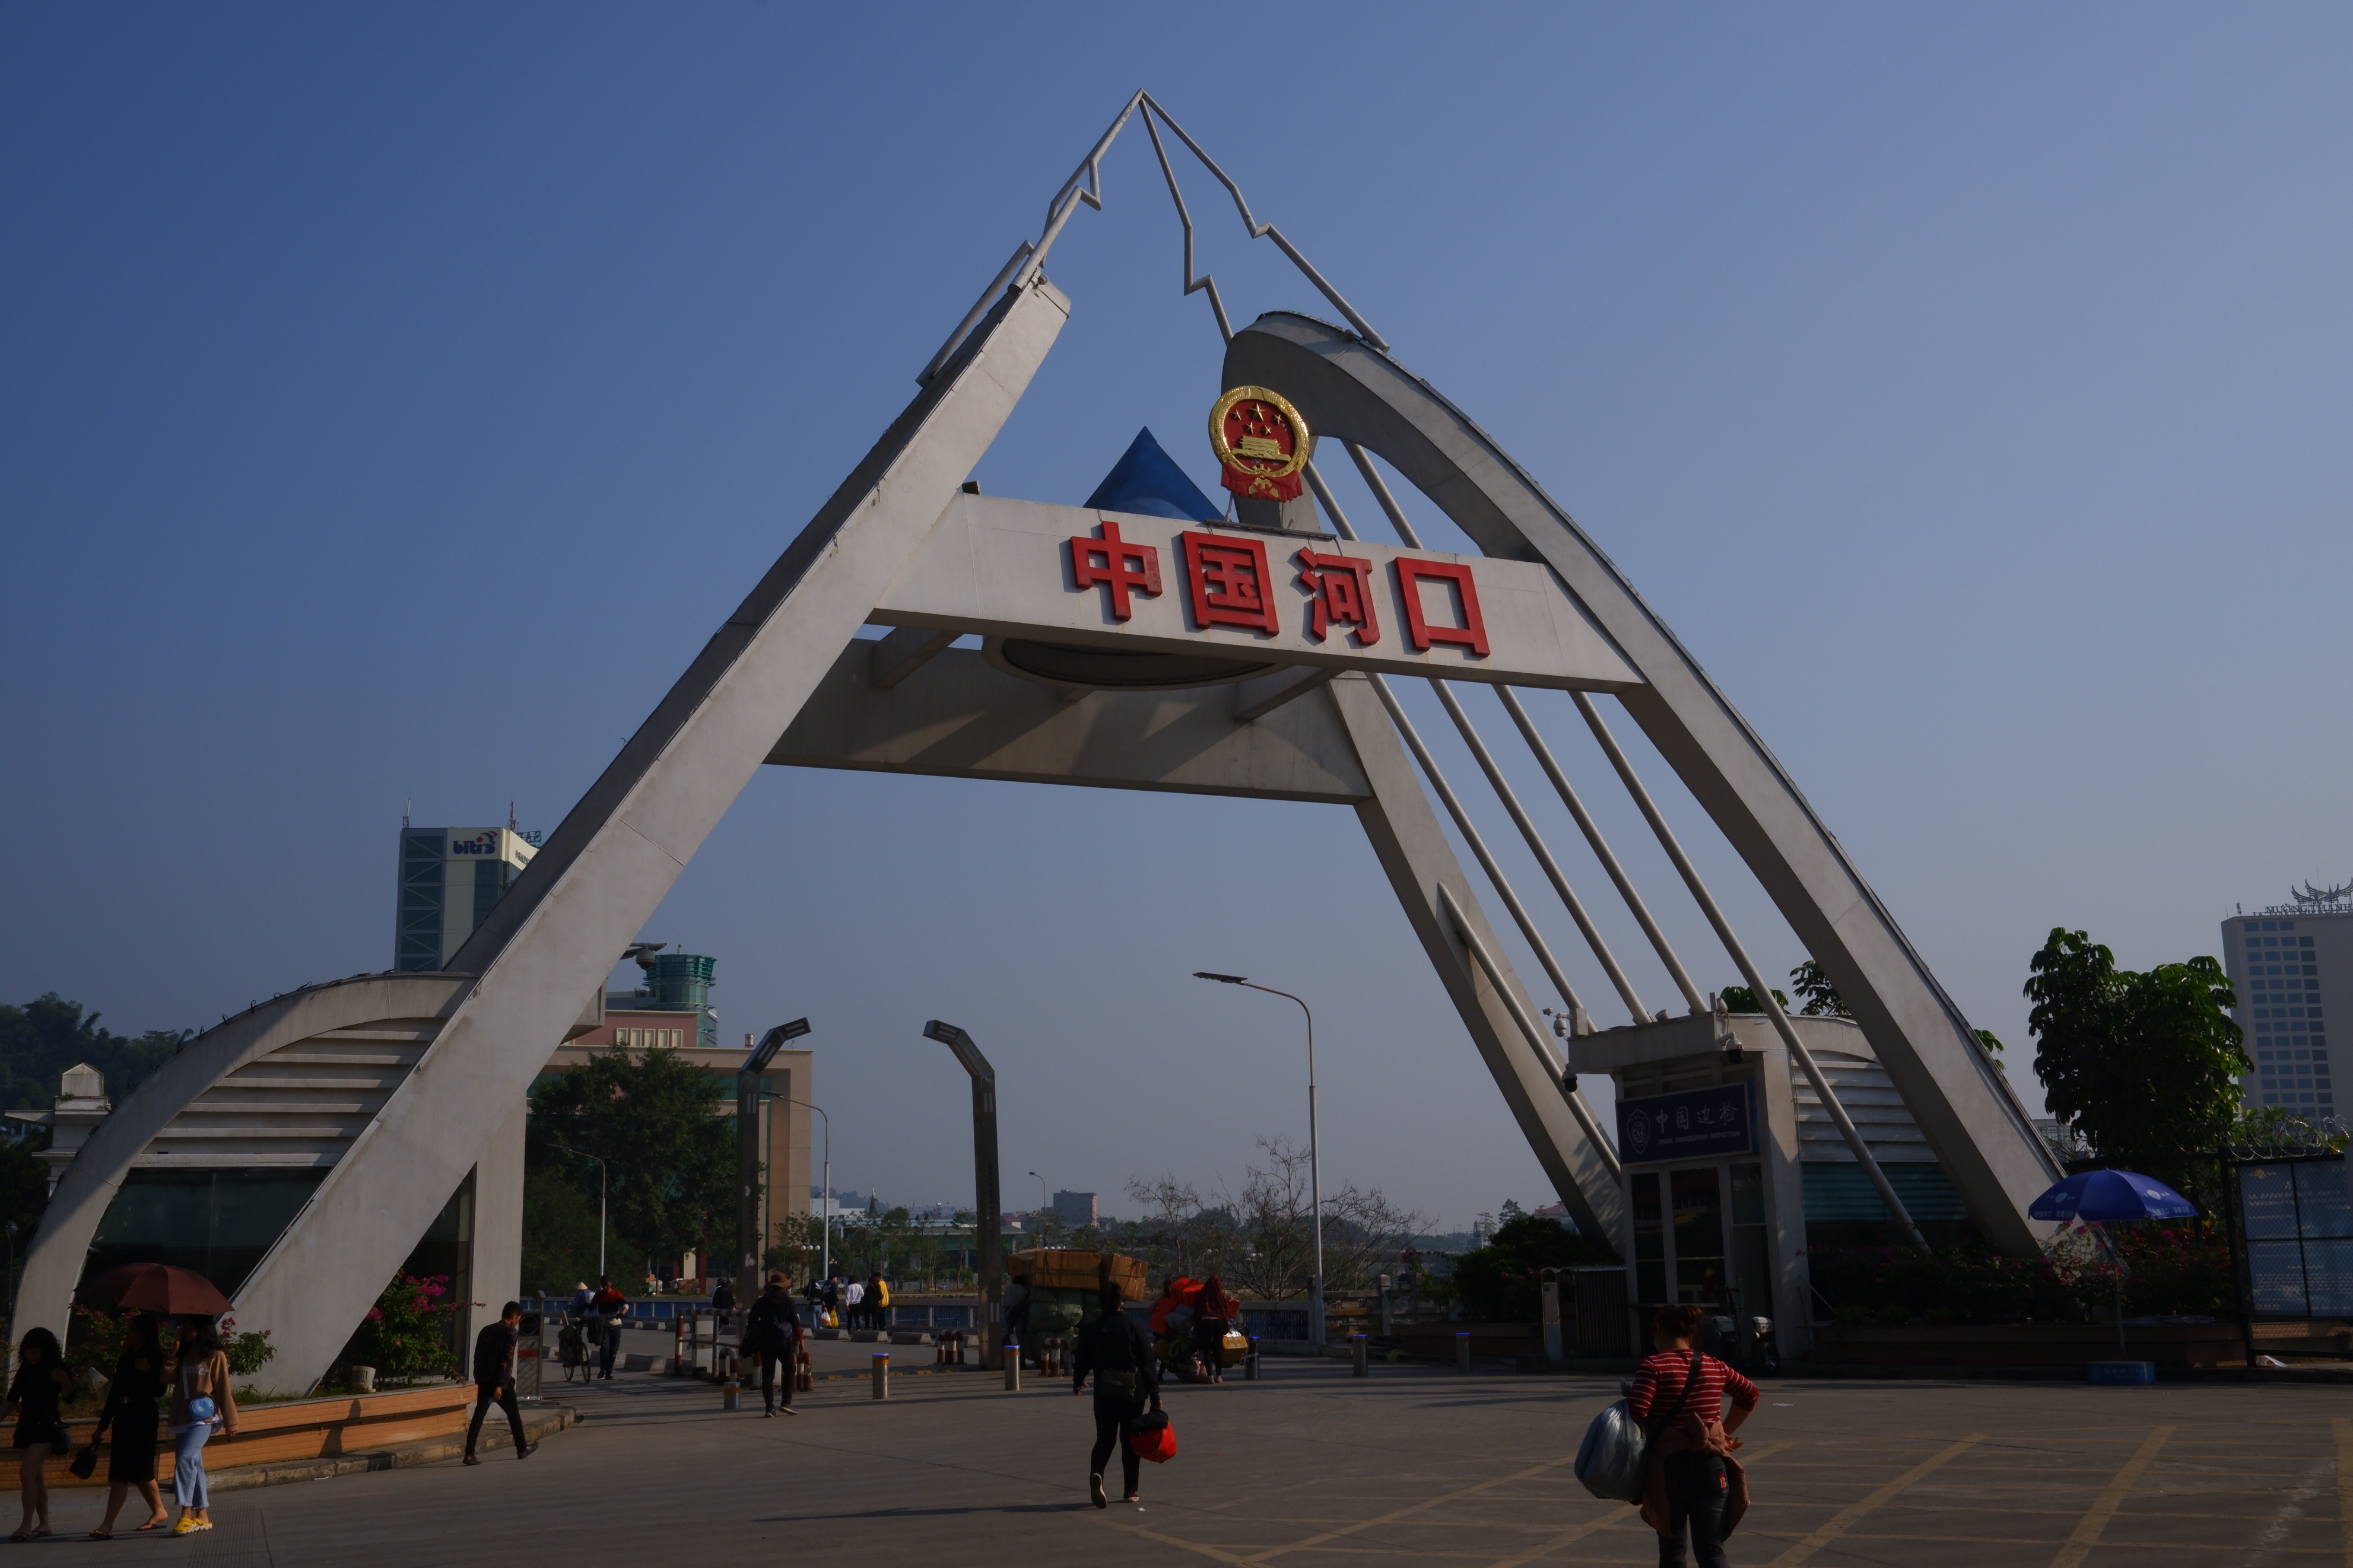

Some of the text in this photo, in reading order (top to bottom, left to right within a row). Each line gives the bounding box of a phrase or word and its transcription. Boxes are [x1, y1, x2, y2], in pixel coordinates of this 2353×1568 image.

[1070, 520, 1491, 657] 中国河口
[2309, 904, 2352, 913] THANH
[1656, 1099, 1738, 1134] 中国边检
[1675, 1134, 1708, 1143] IMMIGRATION
[1710, 1130, 1741, 1139] INSPECTION
